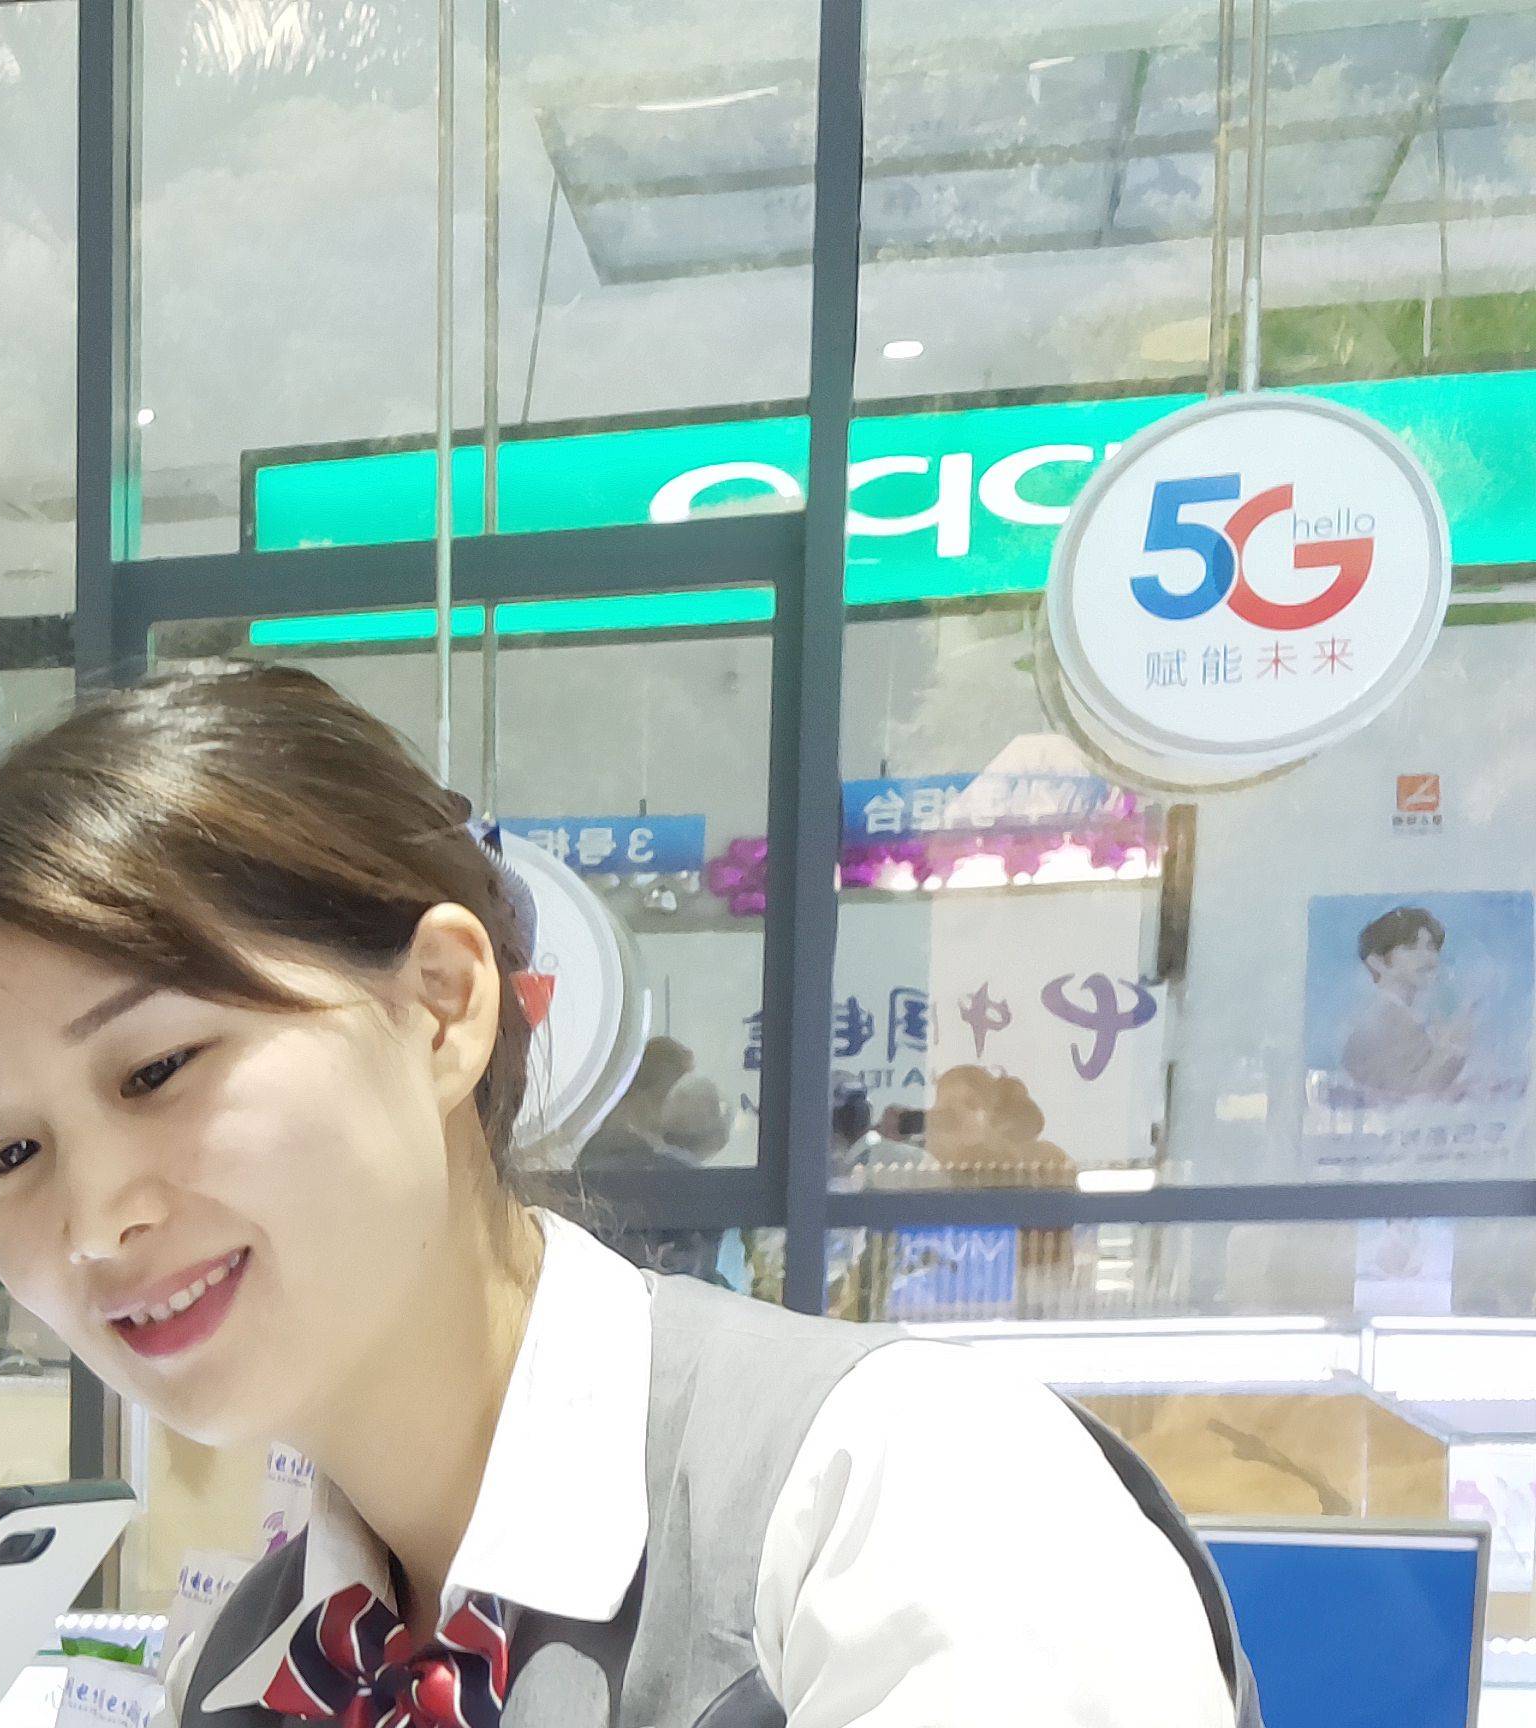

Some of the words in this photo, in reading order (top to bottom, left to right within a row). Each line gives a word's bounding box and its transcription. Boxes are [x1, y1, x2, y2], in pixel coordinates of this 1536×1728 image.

[1292, 507, 1376, 540] hello
[1129, 471, 1375, 631] 5G
[1145, 636, 1354, 690] 赋能未来
